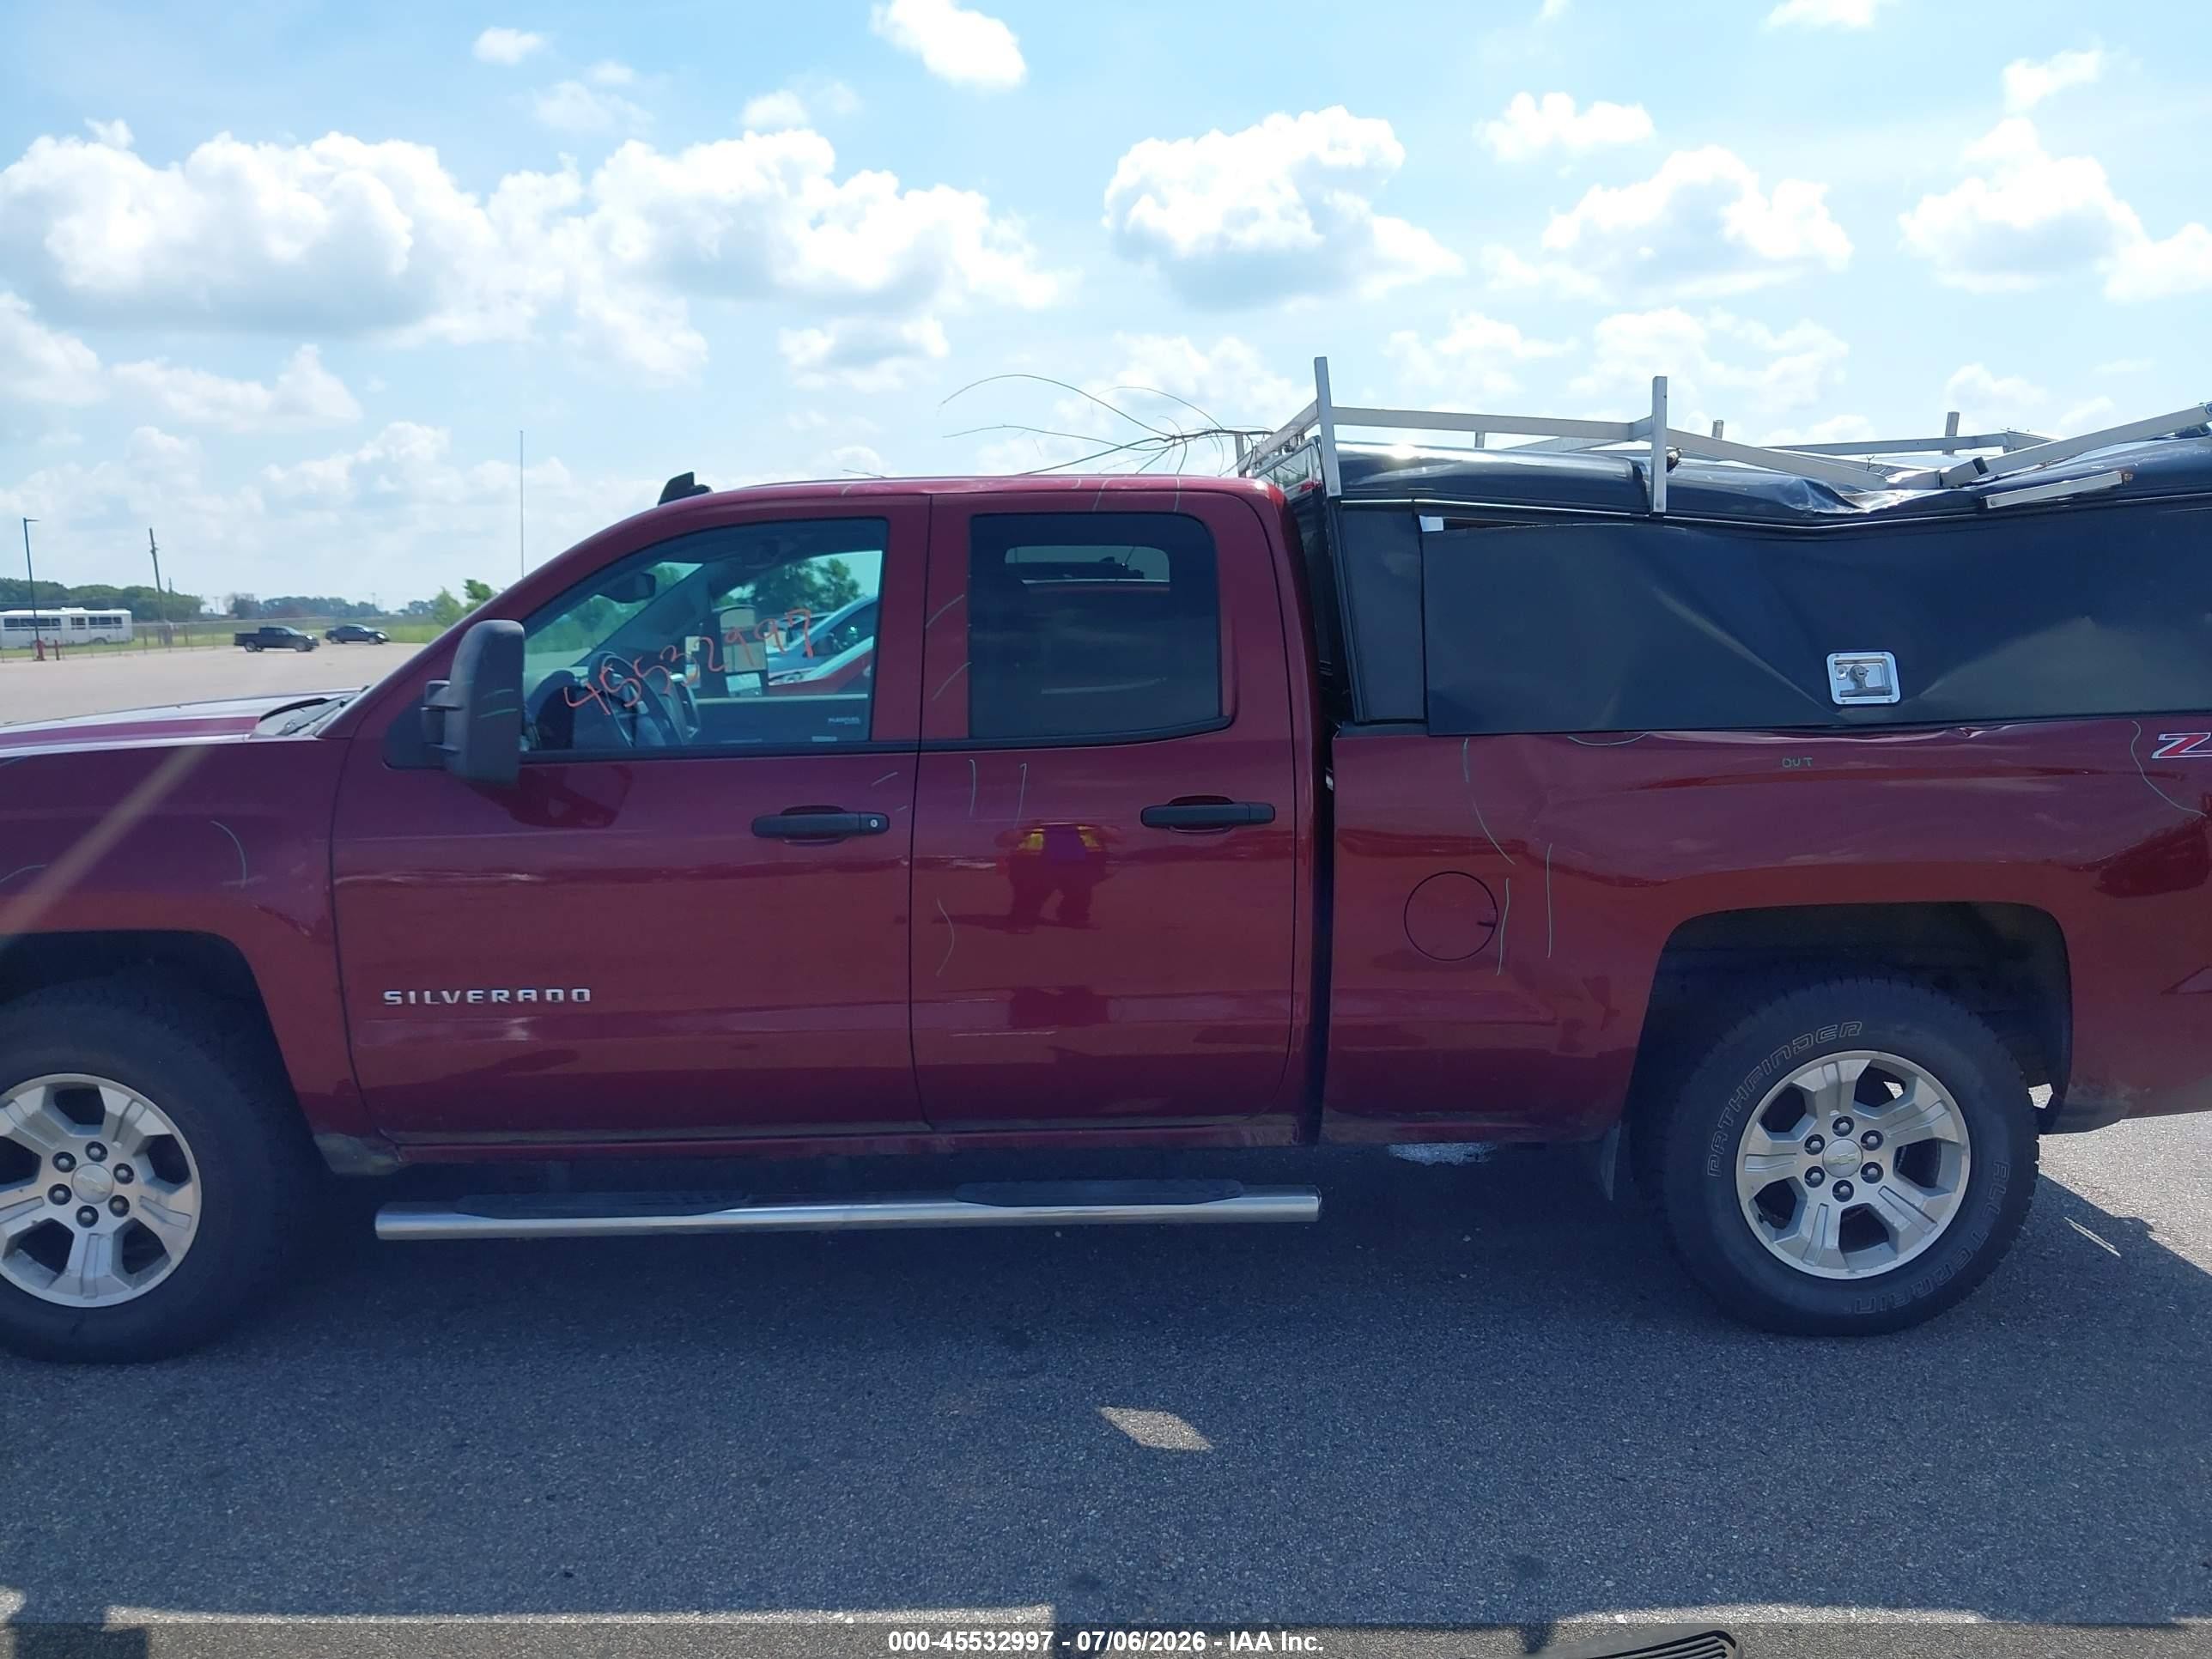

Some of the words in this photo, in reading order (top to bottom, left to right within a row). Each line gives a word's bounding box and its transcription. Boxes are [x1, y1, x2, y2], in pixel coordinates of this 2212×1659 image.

[563, 608, 814, 715] 45532997
[1782, 757, 1814, 769] OUT
[383, 988, 591, 1006] SILVERADO
[1707, 1020, 1863, 1177] PATHFINDER
[1983, 1160, 2011, 1216] ALL
[1854, 1230, 1990, 1315] TERRAIN
